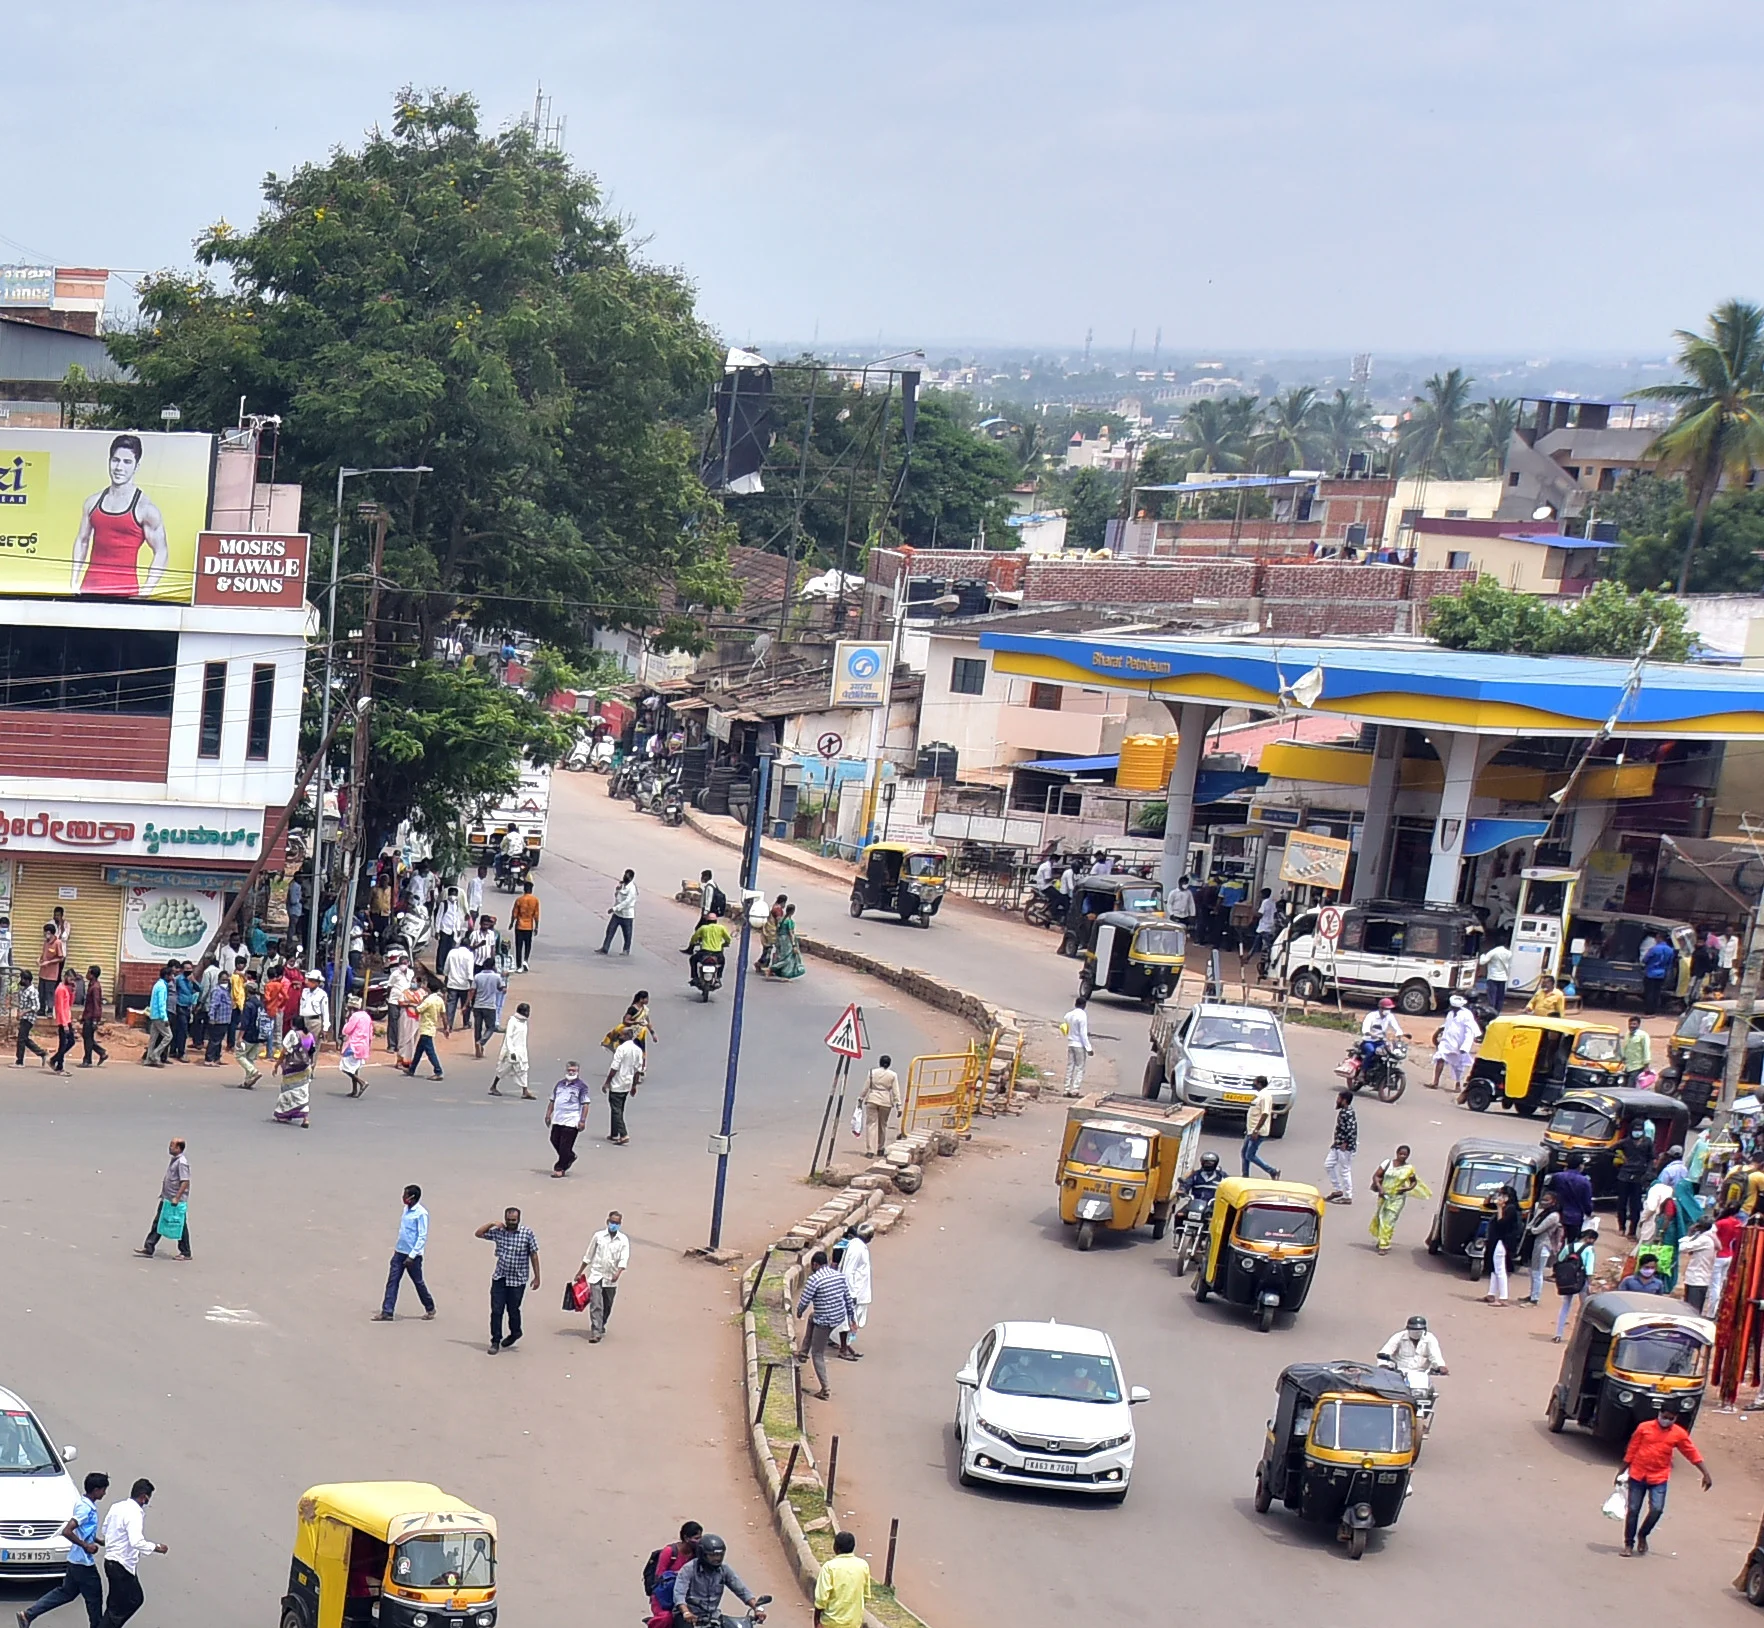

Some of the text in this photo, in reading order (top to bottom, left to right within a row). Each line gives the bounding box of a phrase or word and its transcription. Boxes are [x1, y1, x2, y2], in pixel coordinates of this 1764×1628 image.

[218, 539, 285, 557] MOSES
[204, 557, 300, 578] DHAWALE
[217, 577, 283, 594] & SONS
[1092, 651, 1171, 674] Bharat Petroleum
